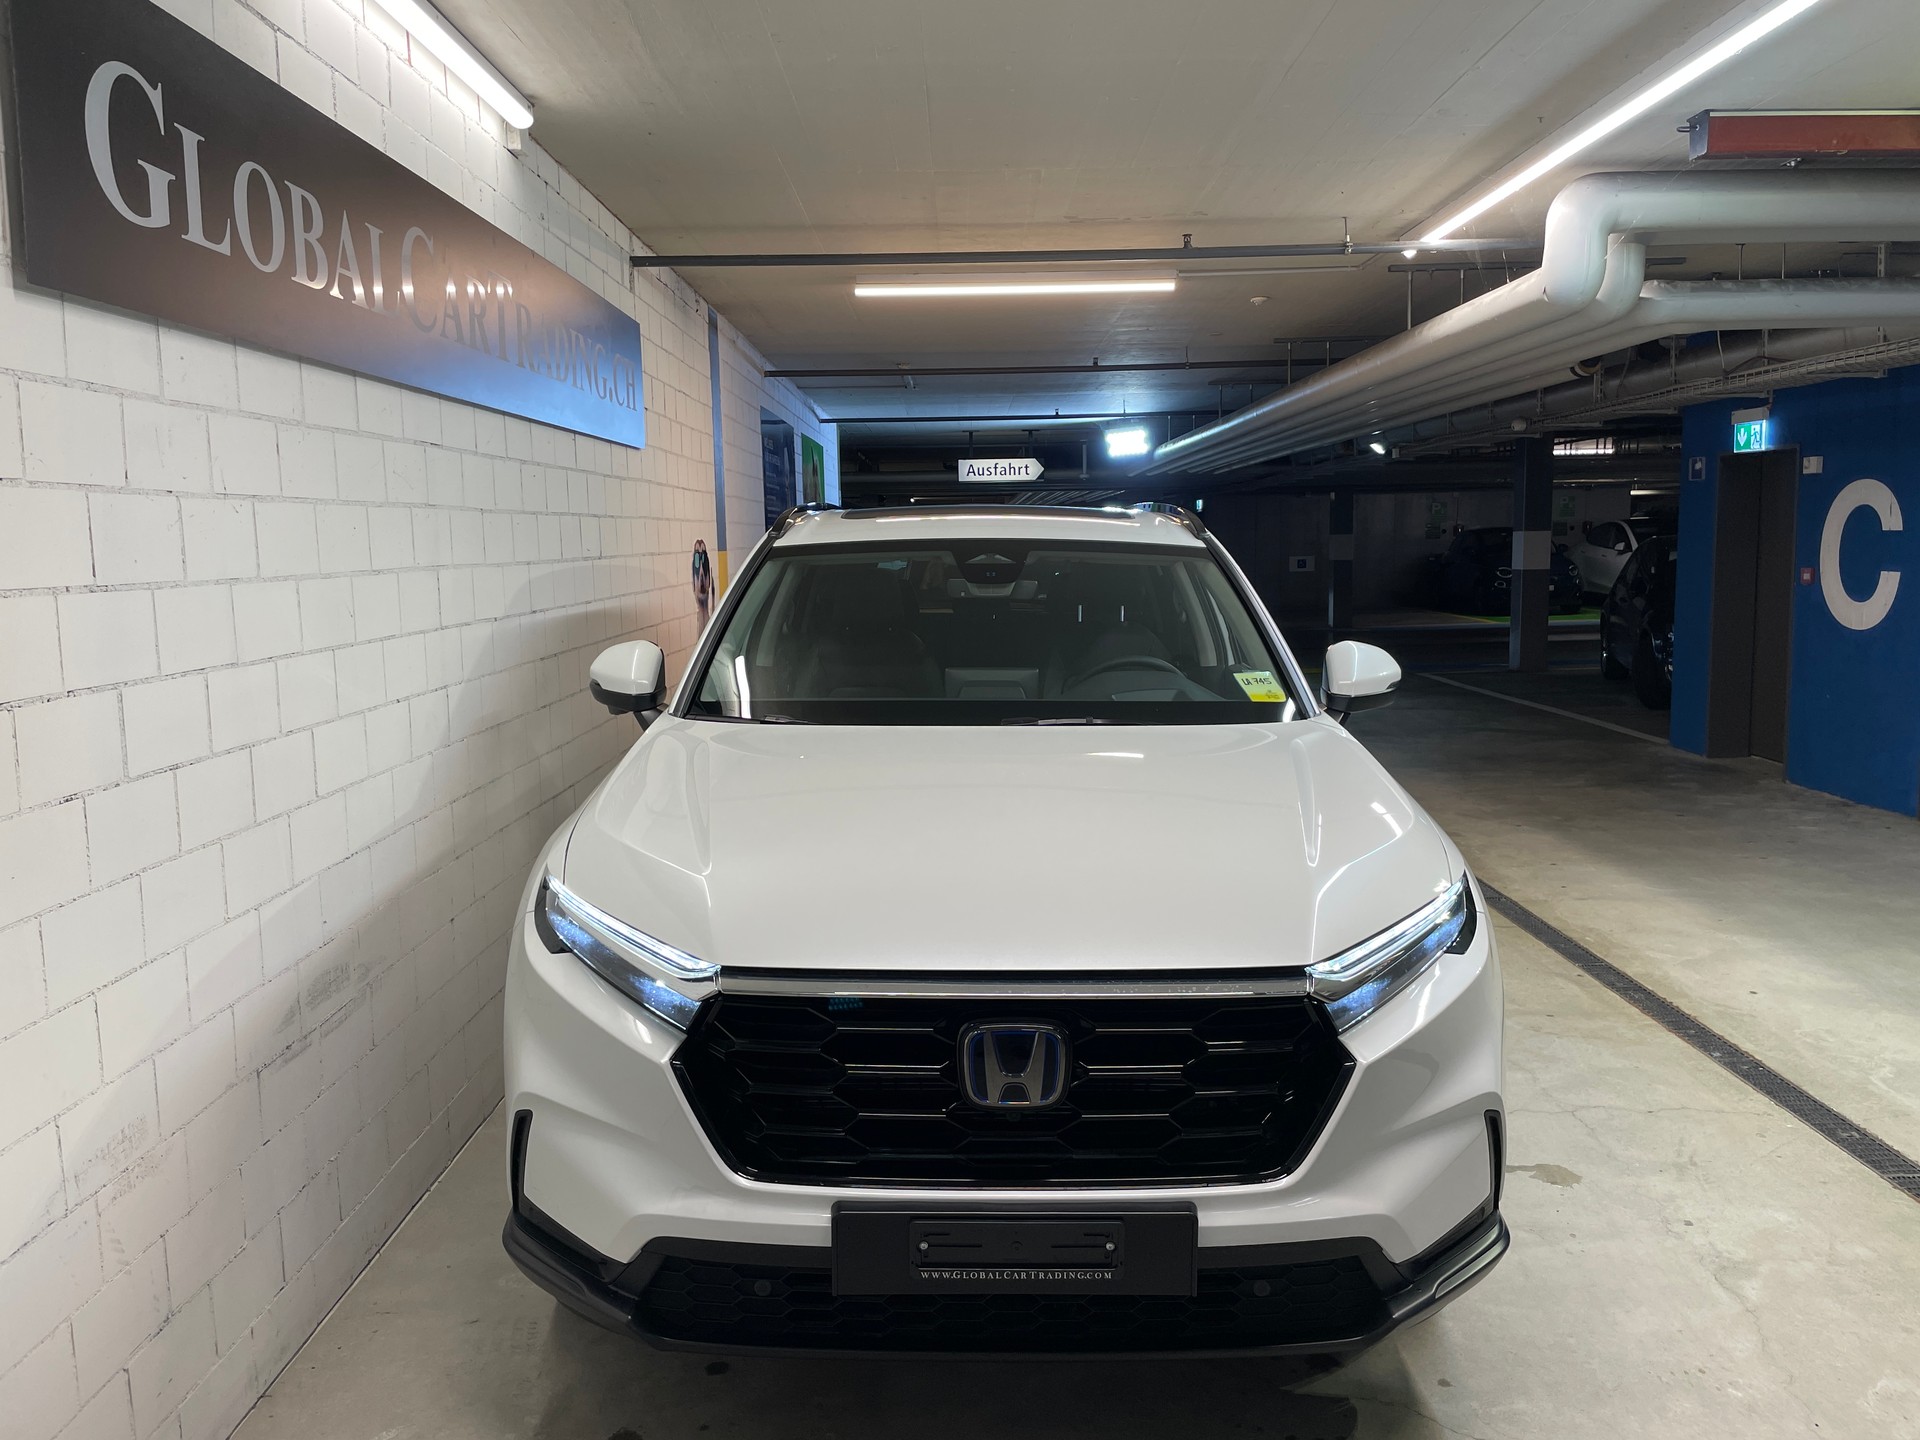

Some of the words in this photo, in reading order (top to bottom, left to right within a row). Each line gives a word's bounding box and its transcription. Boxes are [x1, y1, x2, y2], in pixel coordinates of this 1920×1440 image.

[966, 462, 1030, 477] Ausfahrt
[1819, 478, 1904, 631] C
[920, 1270, 1112, 1280] WWW.GLOBALCARTRADING.COM
